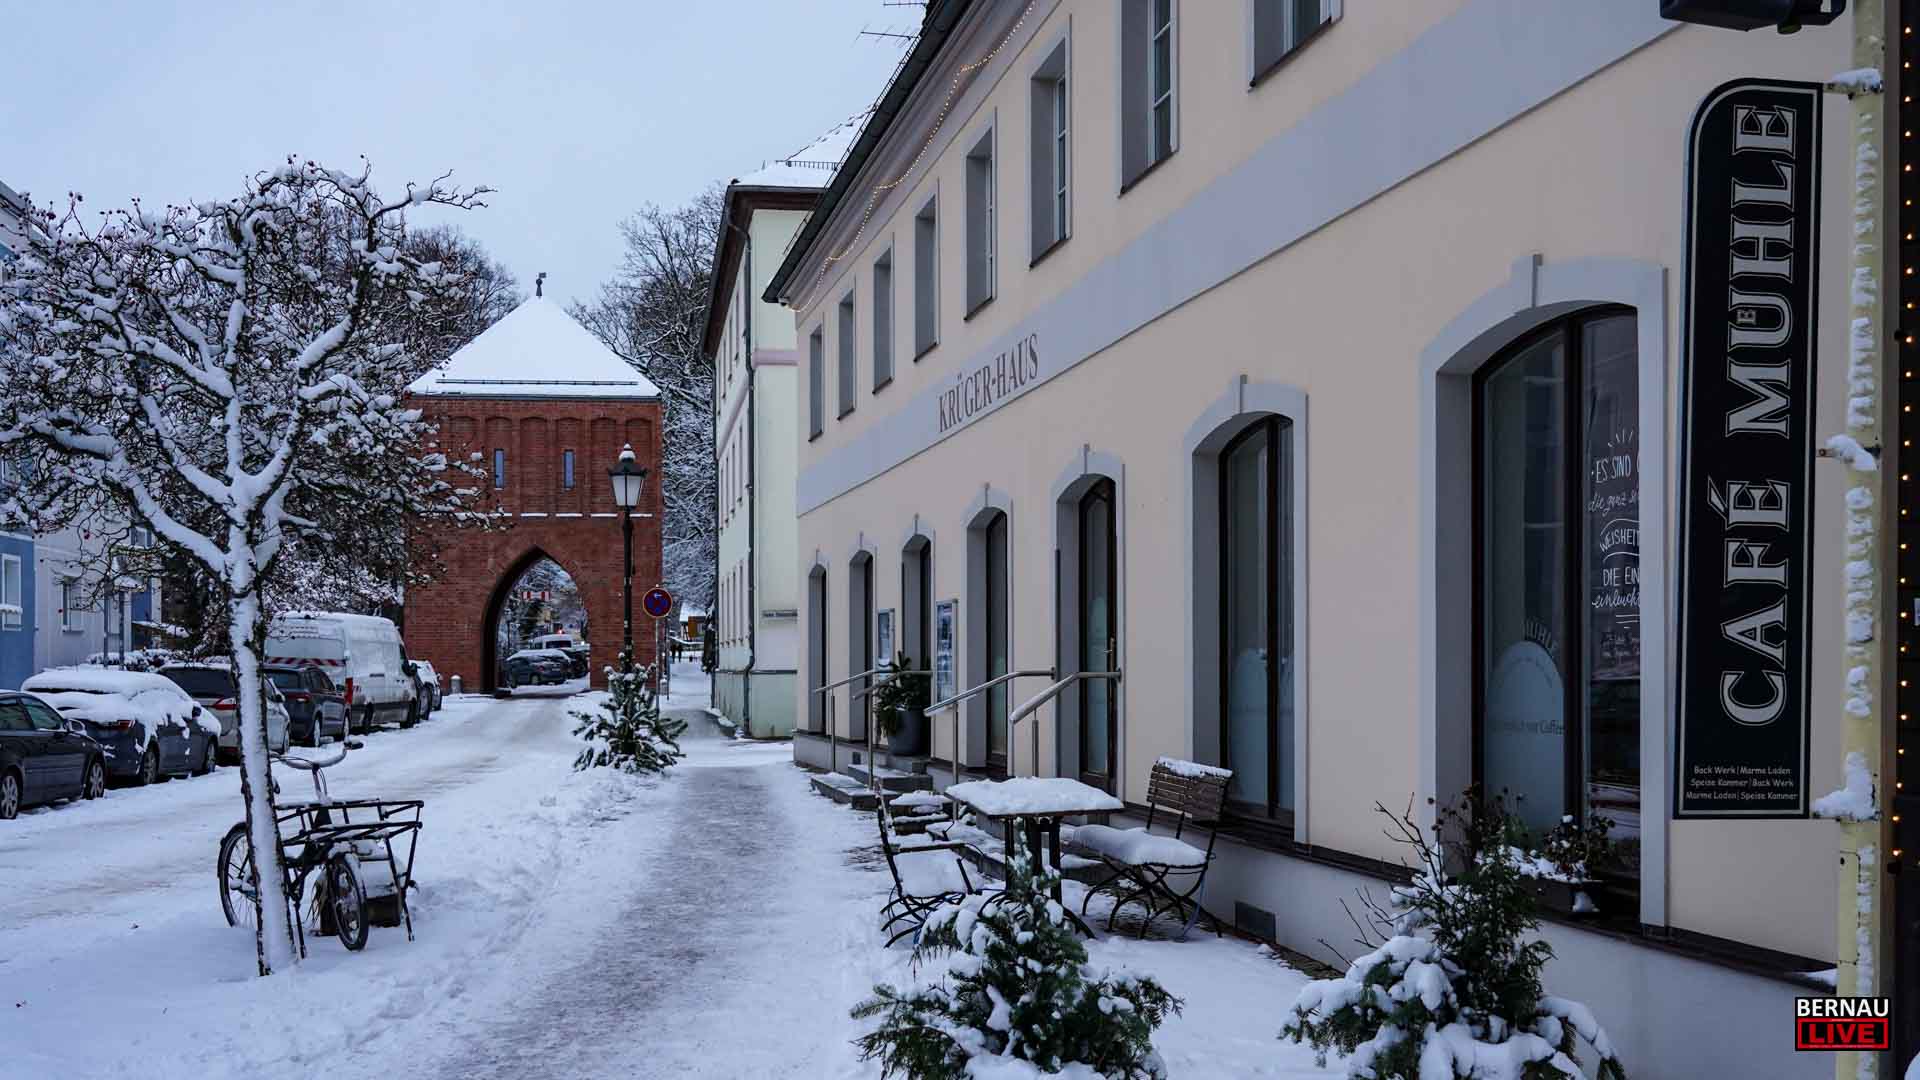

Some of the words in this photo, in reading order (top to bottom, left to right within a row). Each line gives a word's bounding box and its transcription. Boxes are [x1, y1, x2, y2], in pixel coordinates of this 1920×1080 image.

[1611, 455, 1631, 479] SIND
[1603, 567, 1621, 586] DIE
[1707, 475, 1791, 726] CAFÉ
